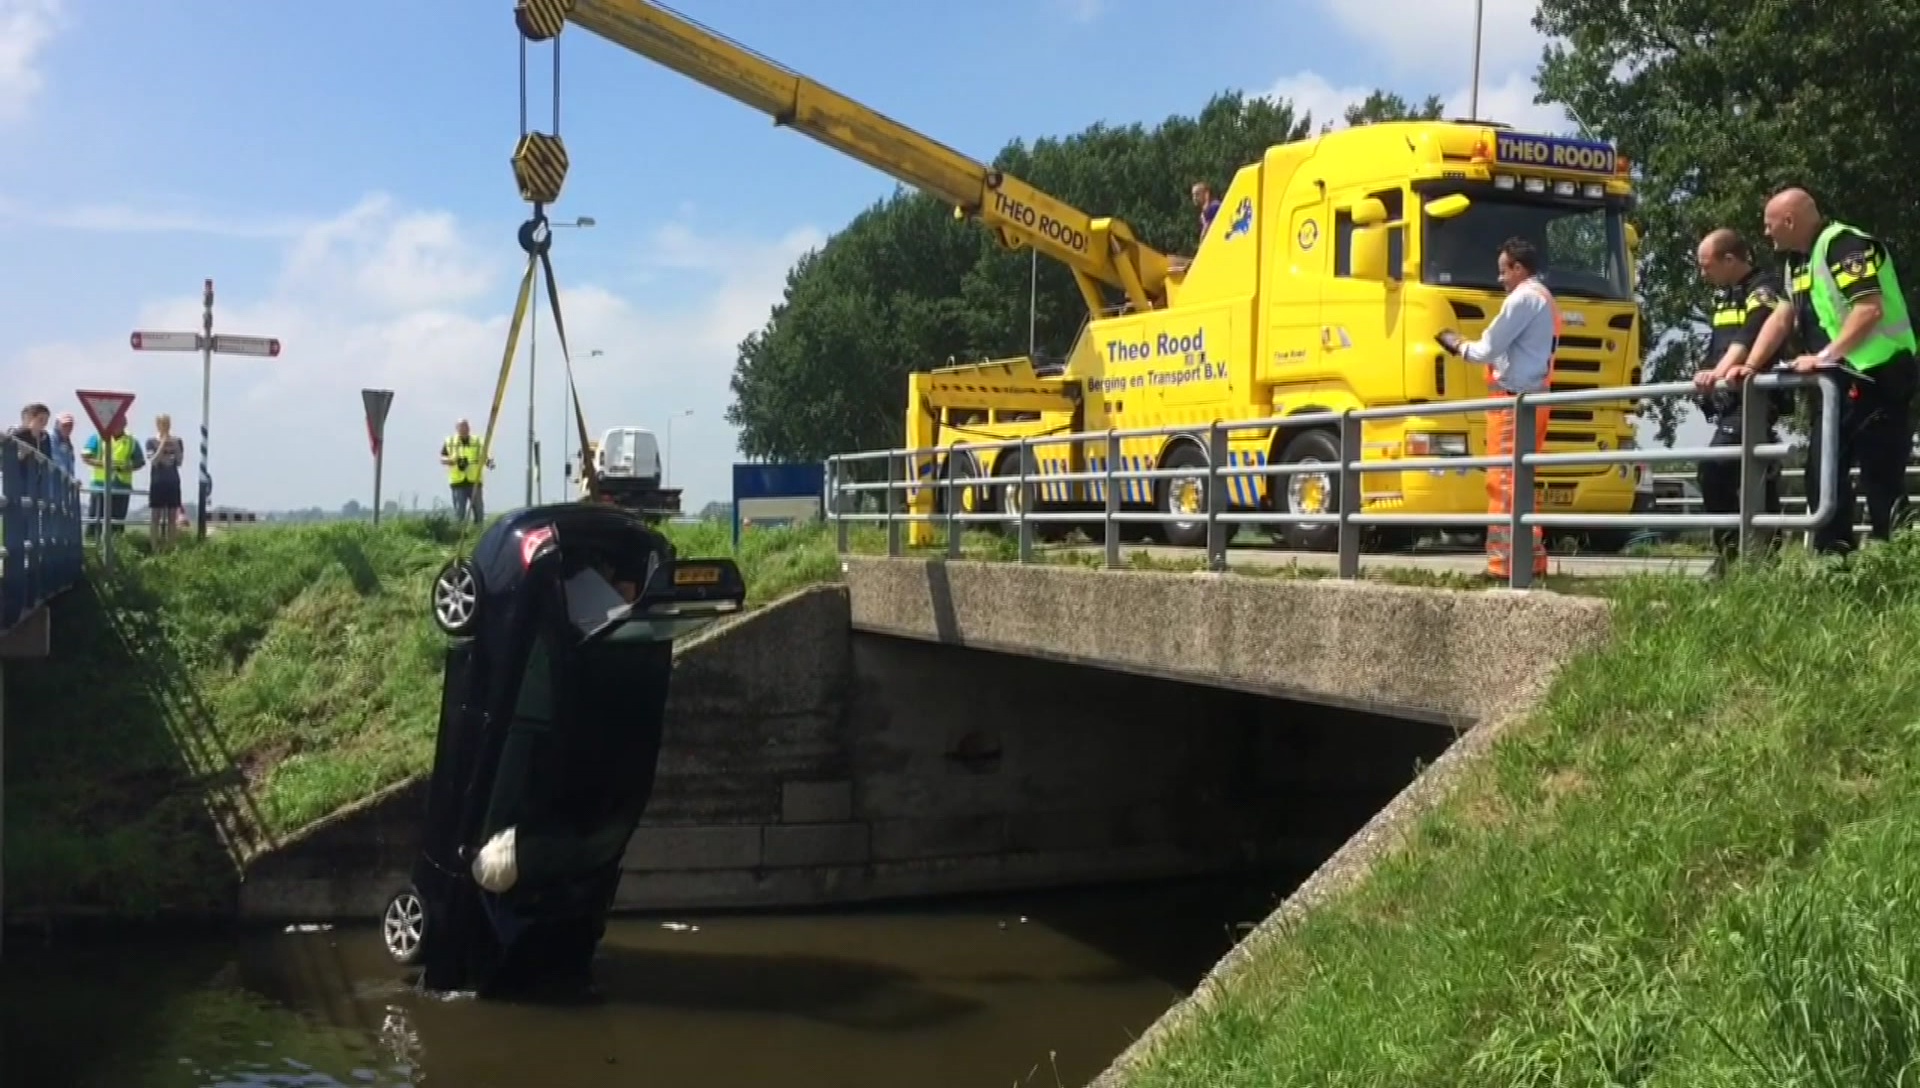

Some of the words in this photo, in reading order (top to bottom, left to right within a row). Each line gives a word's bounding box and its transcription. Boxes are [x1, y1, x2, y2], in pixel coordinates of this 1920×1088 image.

[1498, 138, 1549, 163] THEO
[994, 191, 1036, 227] THEO
[1107, 339, 1150, 363] Theo
[1157, 327, 1203, 356] Rood
[1087, 375, 1126, 393] Berging
[1130, 375, 1144, 388] en
[1147, 367, 1201, 386] Transport
[1204, 360, 1228, 380] B.V.
